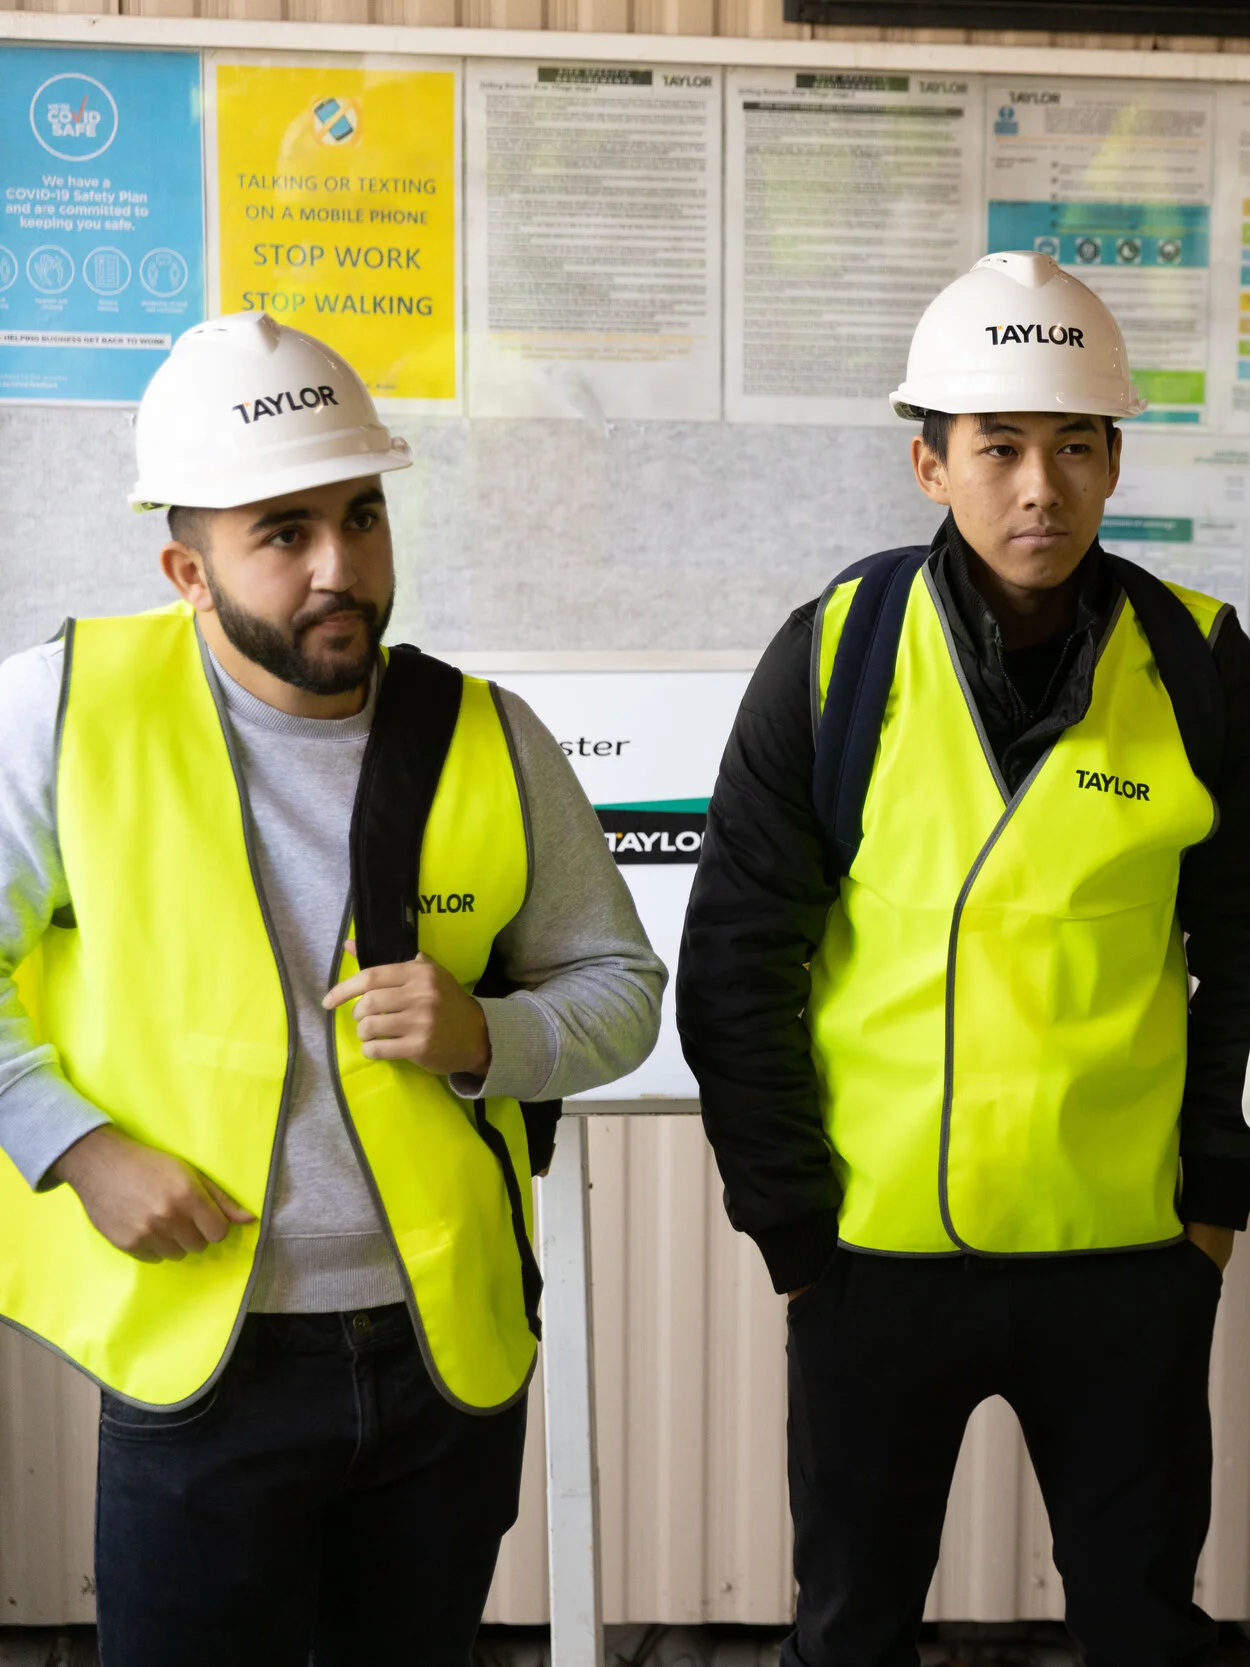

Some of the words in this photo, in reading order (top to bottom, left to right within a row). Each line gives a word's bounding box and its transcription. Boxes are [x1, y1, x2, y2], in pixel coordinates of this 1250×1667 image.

[662, 75, 713, 88] TAYLOR
[1008, 91, 1061, 104] TAYLOR
[52, 123, 97, 137] SAFE
[42, 174, 64, 187] We
[67, 175, 99, 188] have
[102, 178, 112, 189] a
[238, 174, 318, 191] TALKING
[324, 176, 351, 192] OR
[358, 177, 437, 195] TEXTING
[6, 187, 70, 201] COVID-19
[73, 189, 116, 205] Safety
[119, 190, 148, 204] Plan
[6, 202, 31, 215] and
[34, 204, 56, 215] are
[58, 204, 131, 217] committed
[134, 205, 149, 218] to
[245, 204, 275, 221] ON
[281, 206, 294, 221] A
[300, 207, 364, 223] MOBILE
[370, 209, 428, 225] PHONE
[20, 215, 74, 232] keeping
[77, 219, 102, 231] you
[253, 243, 325, 267] STOP
[334, 246, 422, 270] WORK
[242, 291, 306, 312] STOP
[315, 293, 433, 317] WALKING
[984, 324, 1085, 349] TAYLOR
[232, 385, 340, 425] TAYLOR
[1075, 769, 1151, 802] TAYLOR
[603, 831, 706, 852] TAYLO
